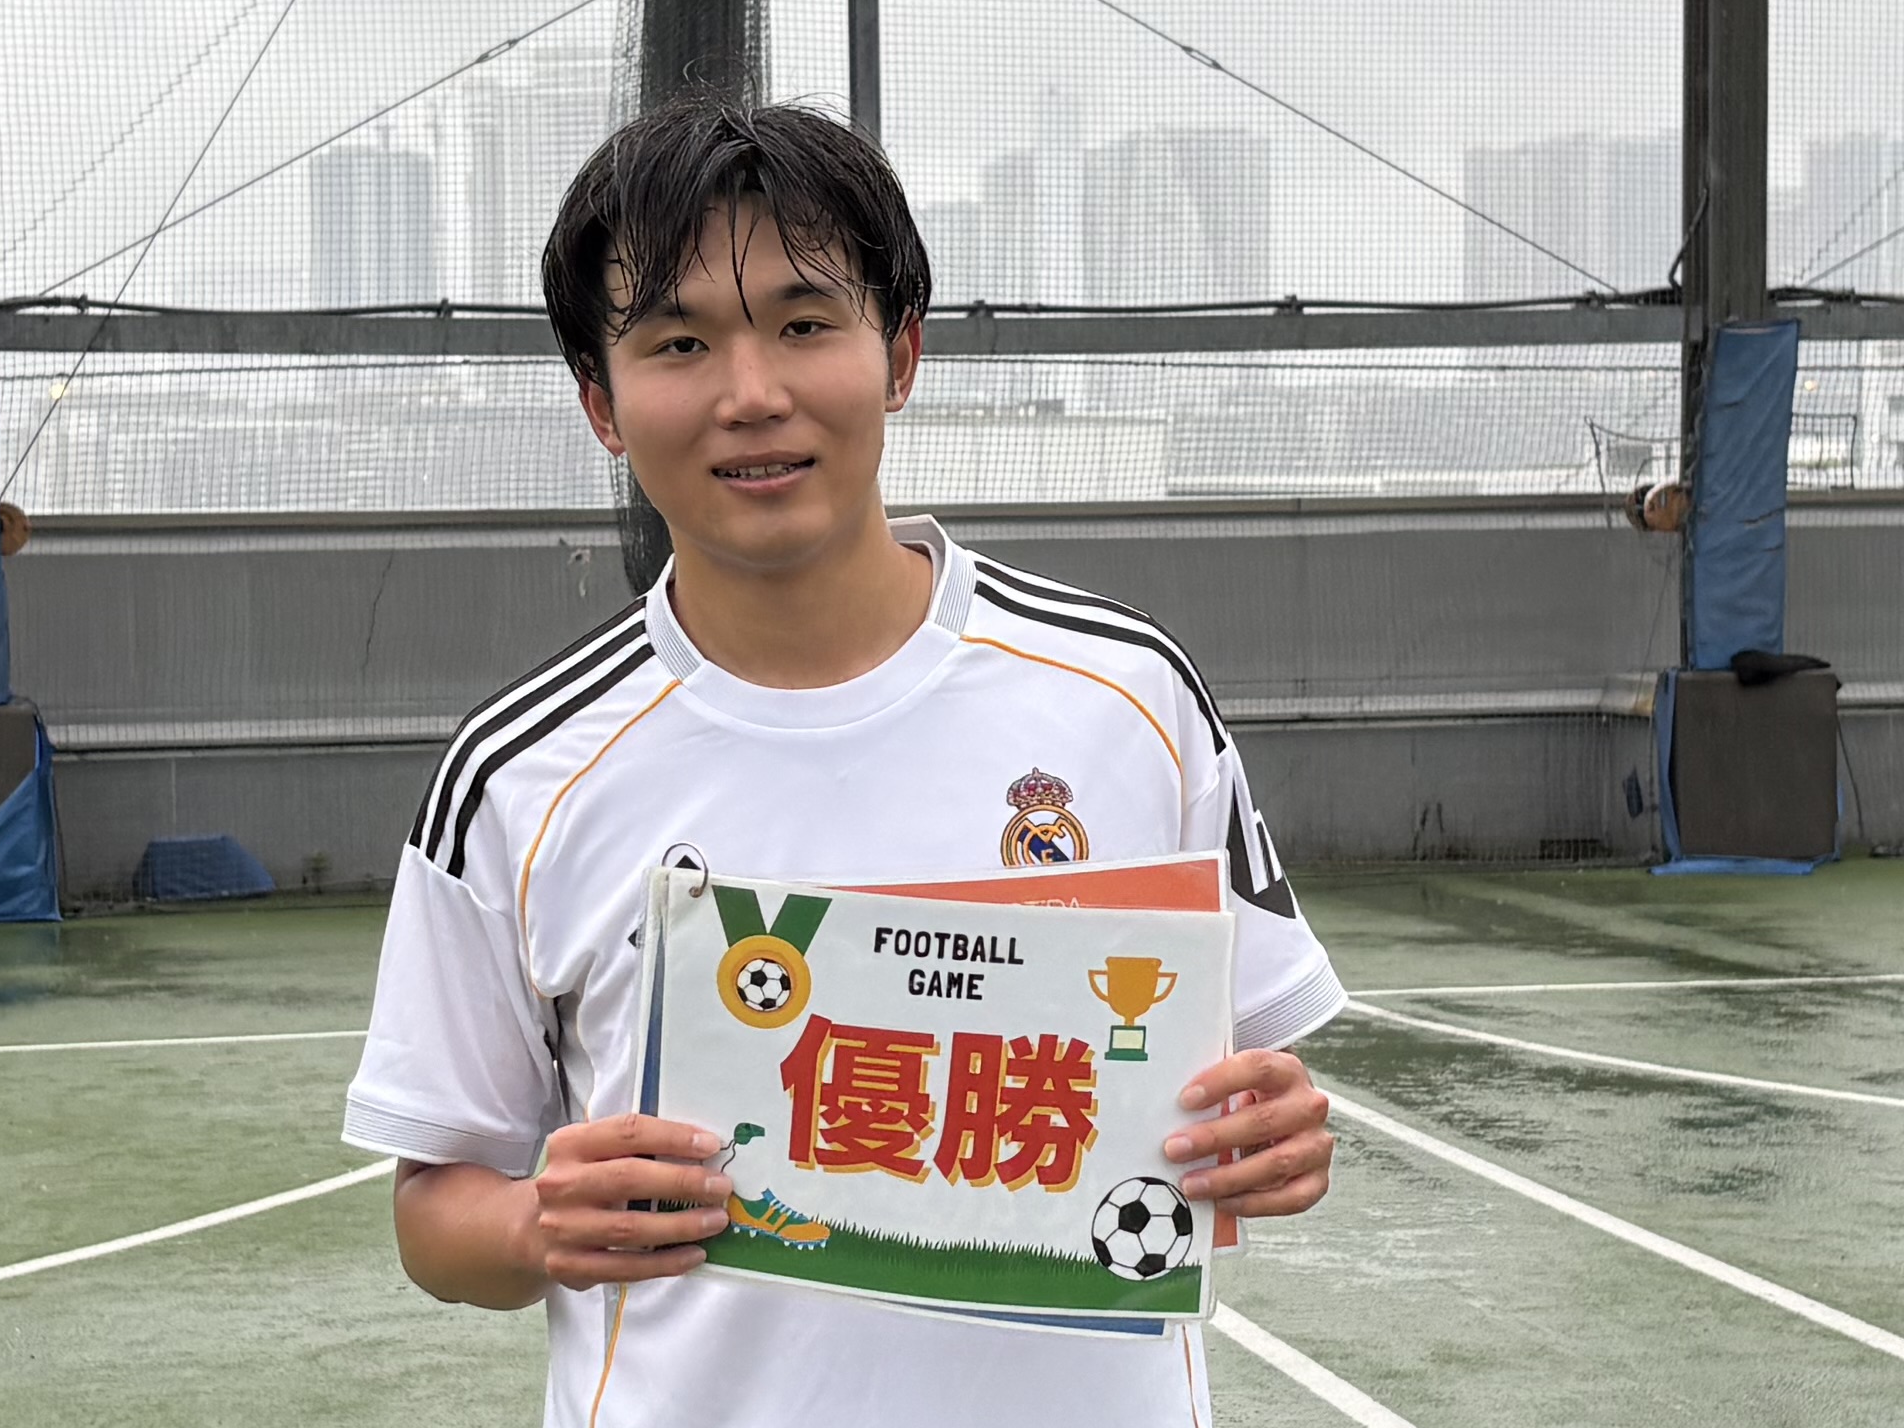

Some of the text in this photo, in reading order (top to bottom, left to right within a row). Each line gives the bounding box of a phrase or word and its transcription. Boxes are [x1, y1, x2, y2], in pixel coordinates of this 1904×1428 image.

[873, 926, 1024, 965] FOOTBALL
[908, 968, 985, 1000] GAME
[779, 1012, 1099, 1193] 優勝
